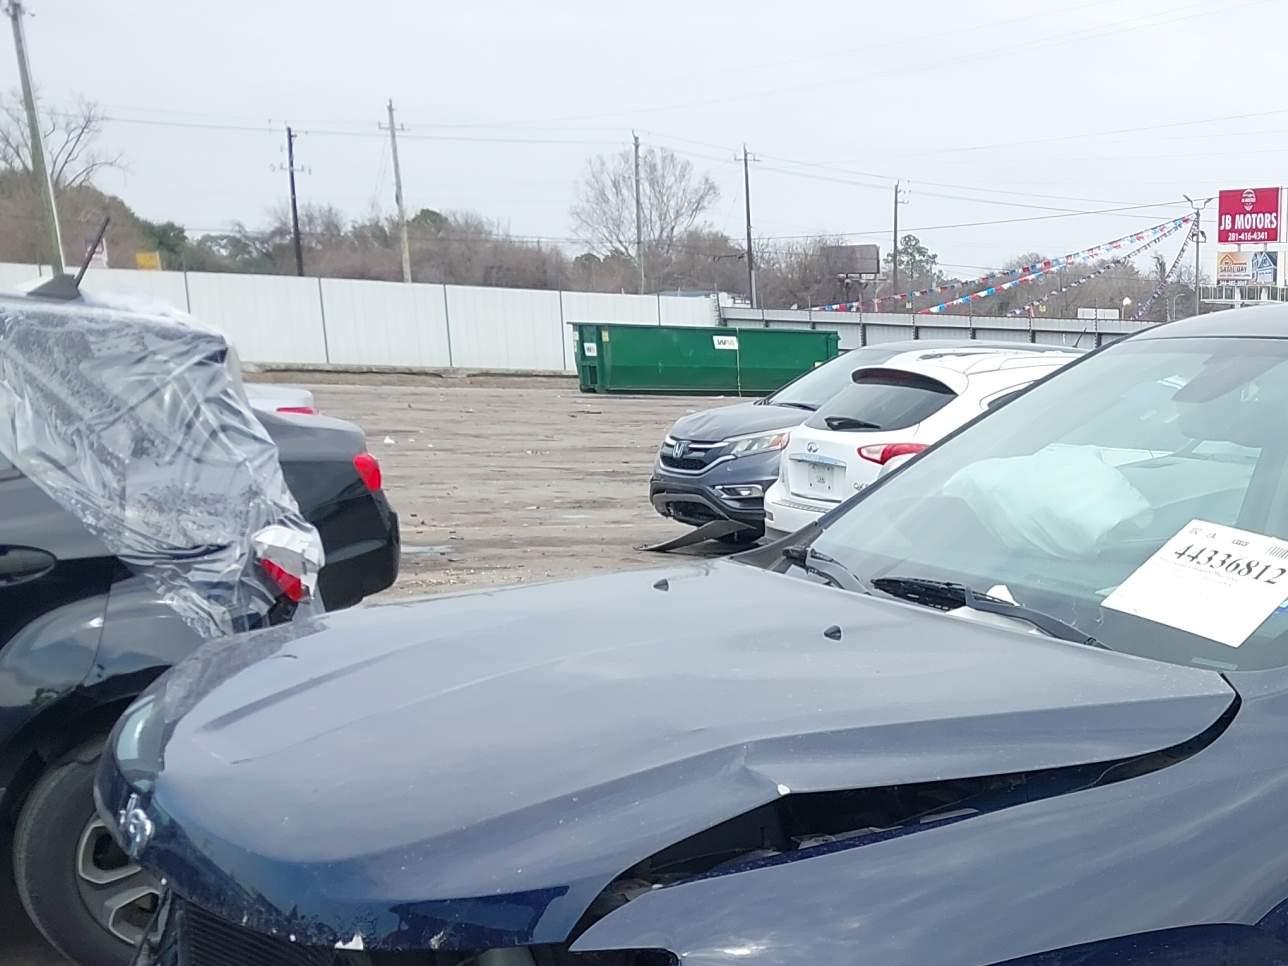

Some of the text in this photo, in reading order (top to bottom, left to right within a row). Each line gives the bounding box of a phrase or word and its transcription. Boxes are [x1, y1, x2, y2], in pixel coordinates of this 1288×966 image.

[1220, 212, 1277, 230] JB MOTORS
[1174, 543, 1287, 585] 44336812
